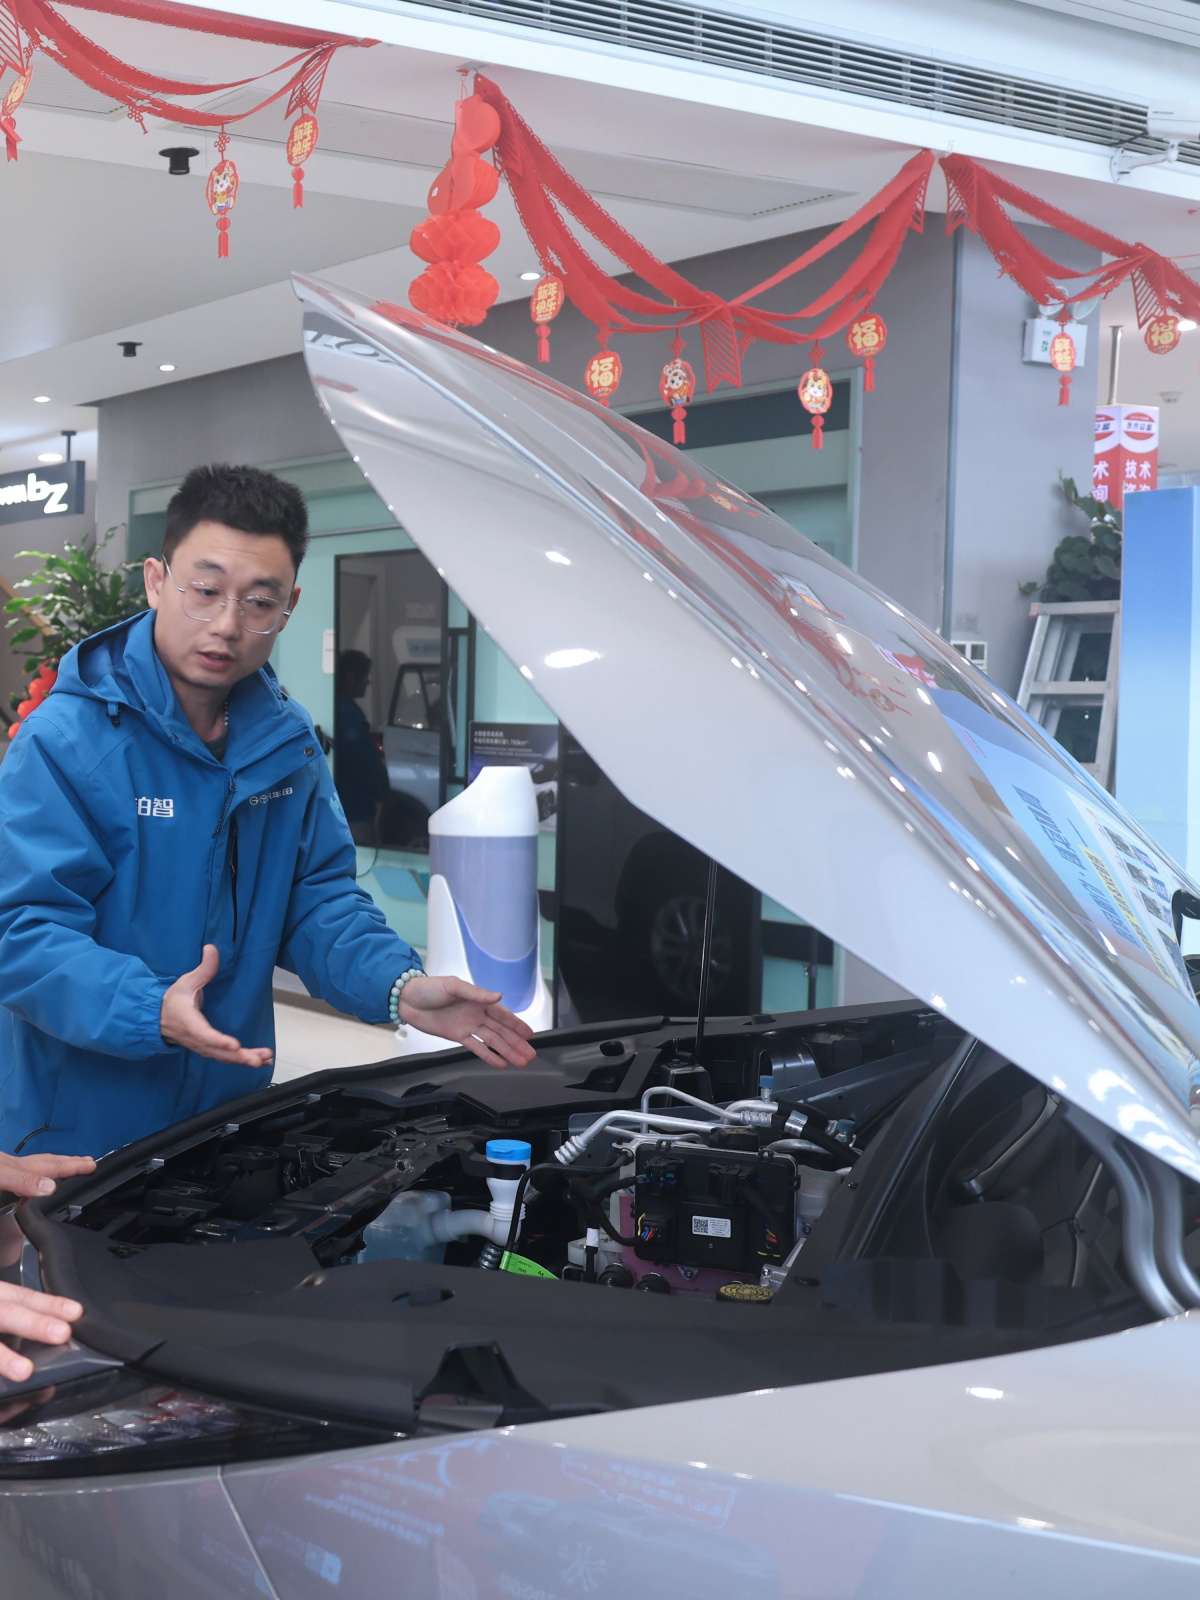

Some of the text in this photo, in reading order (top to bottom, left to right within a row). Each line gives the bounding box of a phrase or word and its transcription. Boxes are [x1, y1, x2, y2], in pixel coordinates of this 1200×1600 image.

[852, 318, 879, 349] 福
[1151, 319, 1175, 346] 福
[590, 356, 614, 388] 福
